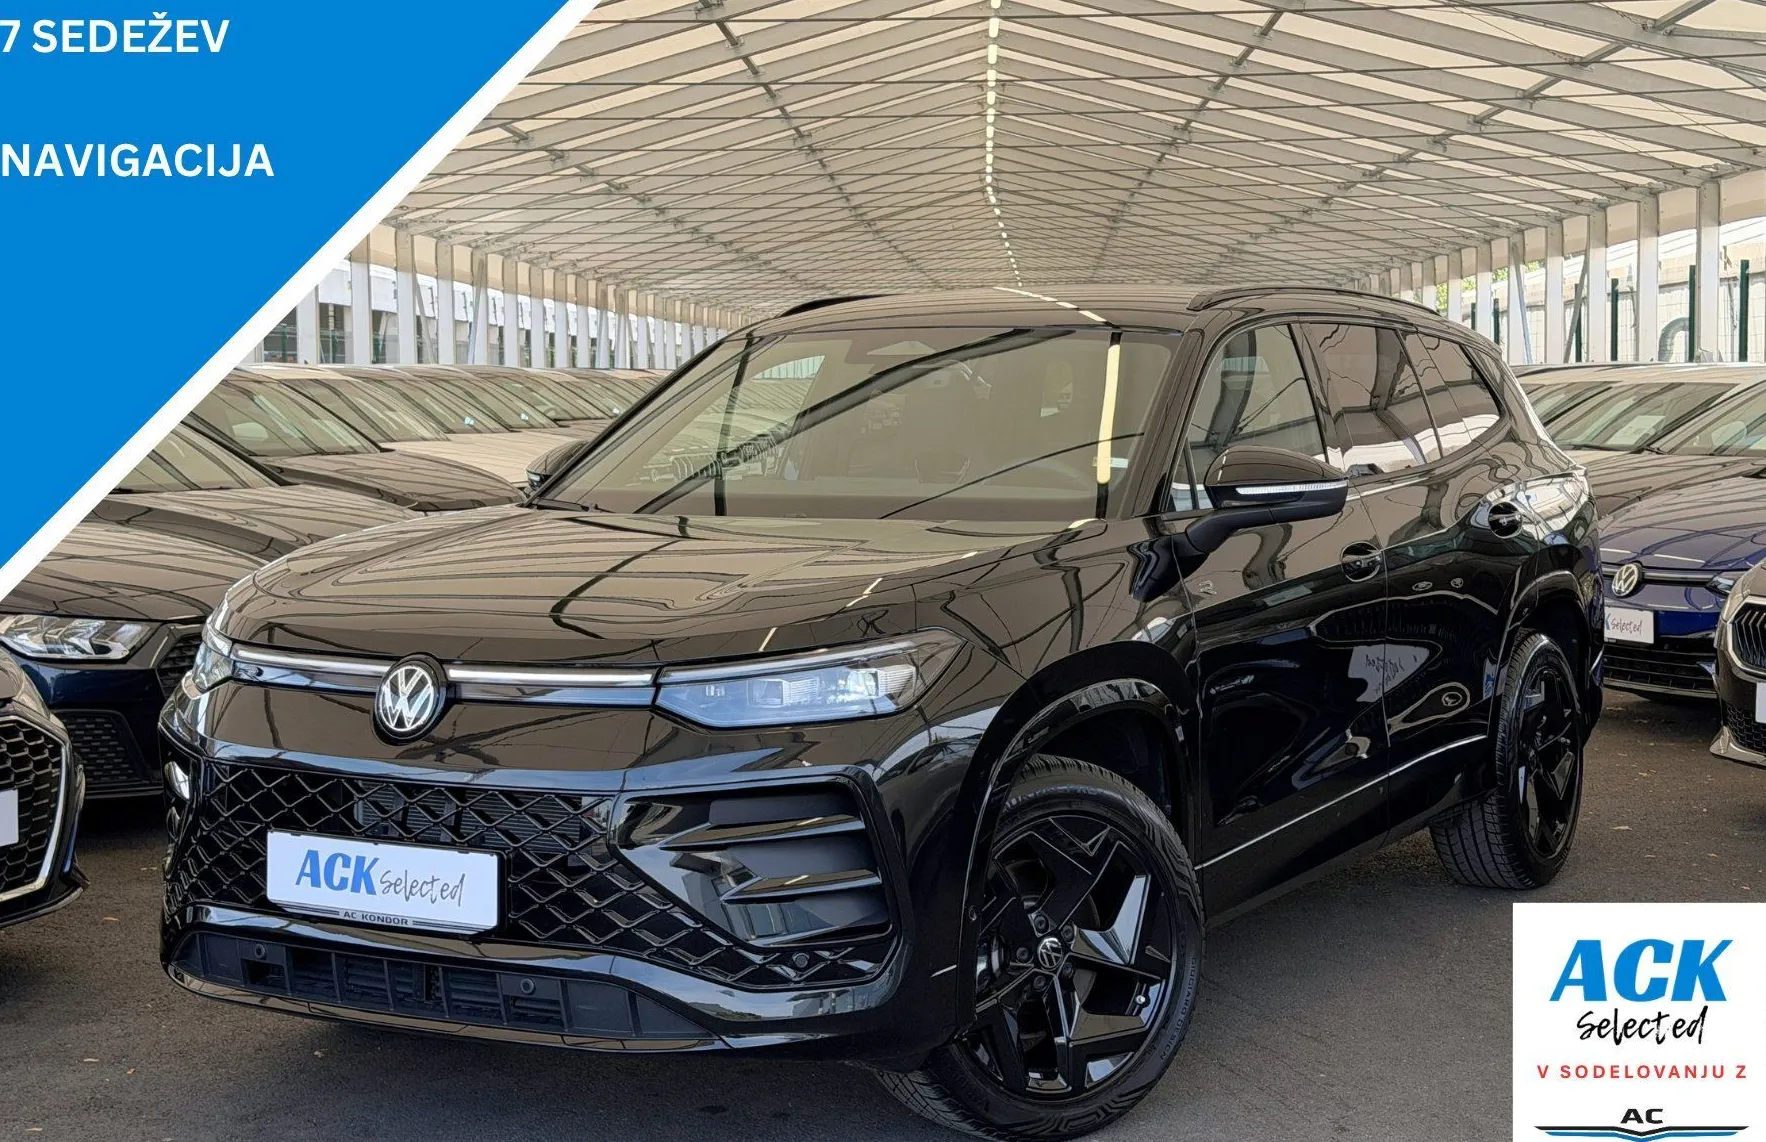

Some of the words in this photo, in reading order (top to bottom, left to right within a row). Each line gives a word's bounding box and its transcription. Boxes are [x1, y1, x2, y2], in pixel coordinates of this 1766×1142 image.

[1611, 618, 1643, 635] Selected
[295, 849, 379, 896] ACK
[379, 869, 466, 907] Selected
[343, 911, 357, 919] AC
[361, 913, 409, 926] KONDOR
[1160, 1019, 1187, 1060] DESIGN
